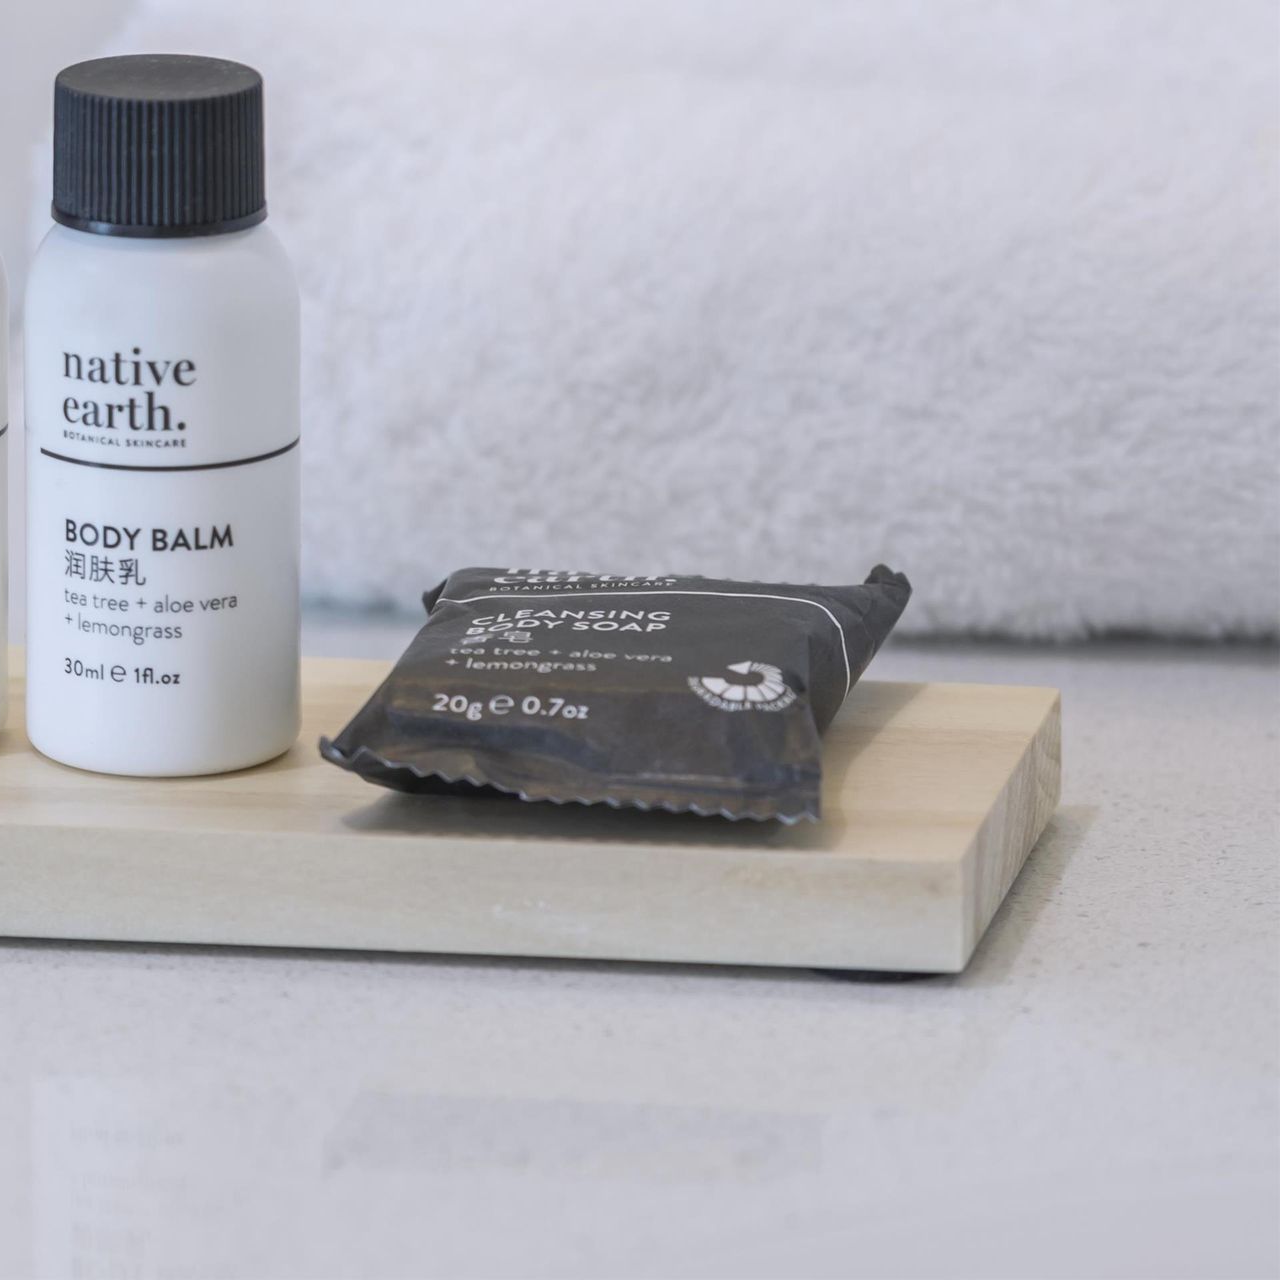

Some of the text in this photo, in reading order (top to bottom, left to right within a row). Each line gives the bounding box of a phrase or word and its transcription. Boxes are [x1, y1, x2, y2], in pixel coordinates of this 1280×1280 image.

[63, 347, 196, 386] native
[63, 391, 187, 431] earth.
[63, 430, 187, 448] BOTANICAL SKINCARE
[65, 519, 233, 552] BODY BALM
[64, 549, 147, 586] 润肤乳
[591, 581, 674, 589] SKINCARE
[65, 588, 238, 613] tea tree + aloe vera
[65, 612, 183, 645] + lemongrass
[466, 620, 667, 635] BODY SOAP
[471, 609, 672, 626] CLEANSING
[465, 658, 596, 673] lemongrass
[493, 647, 541, 656] tree
[569, 649, 616, 660] aloe
[625, 654, 672, 662] vera
[64, 658, 103, 680] 30ml
[134, 668, 181, 684] 1fl.oz
[432, 694, 483, 720] 20g
[522, 696, 589, 719] 0.7oz
